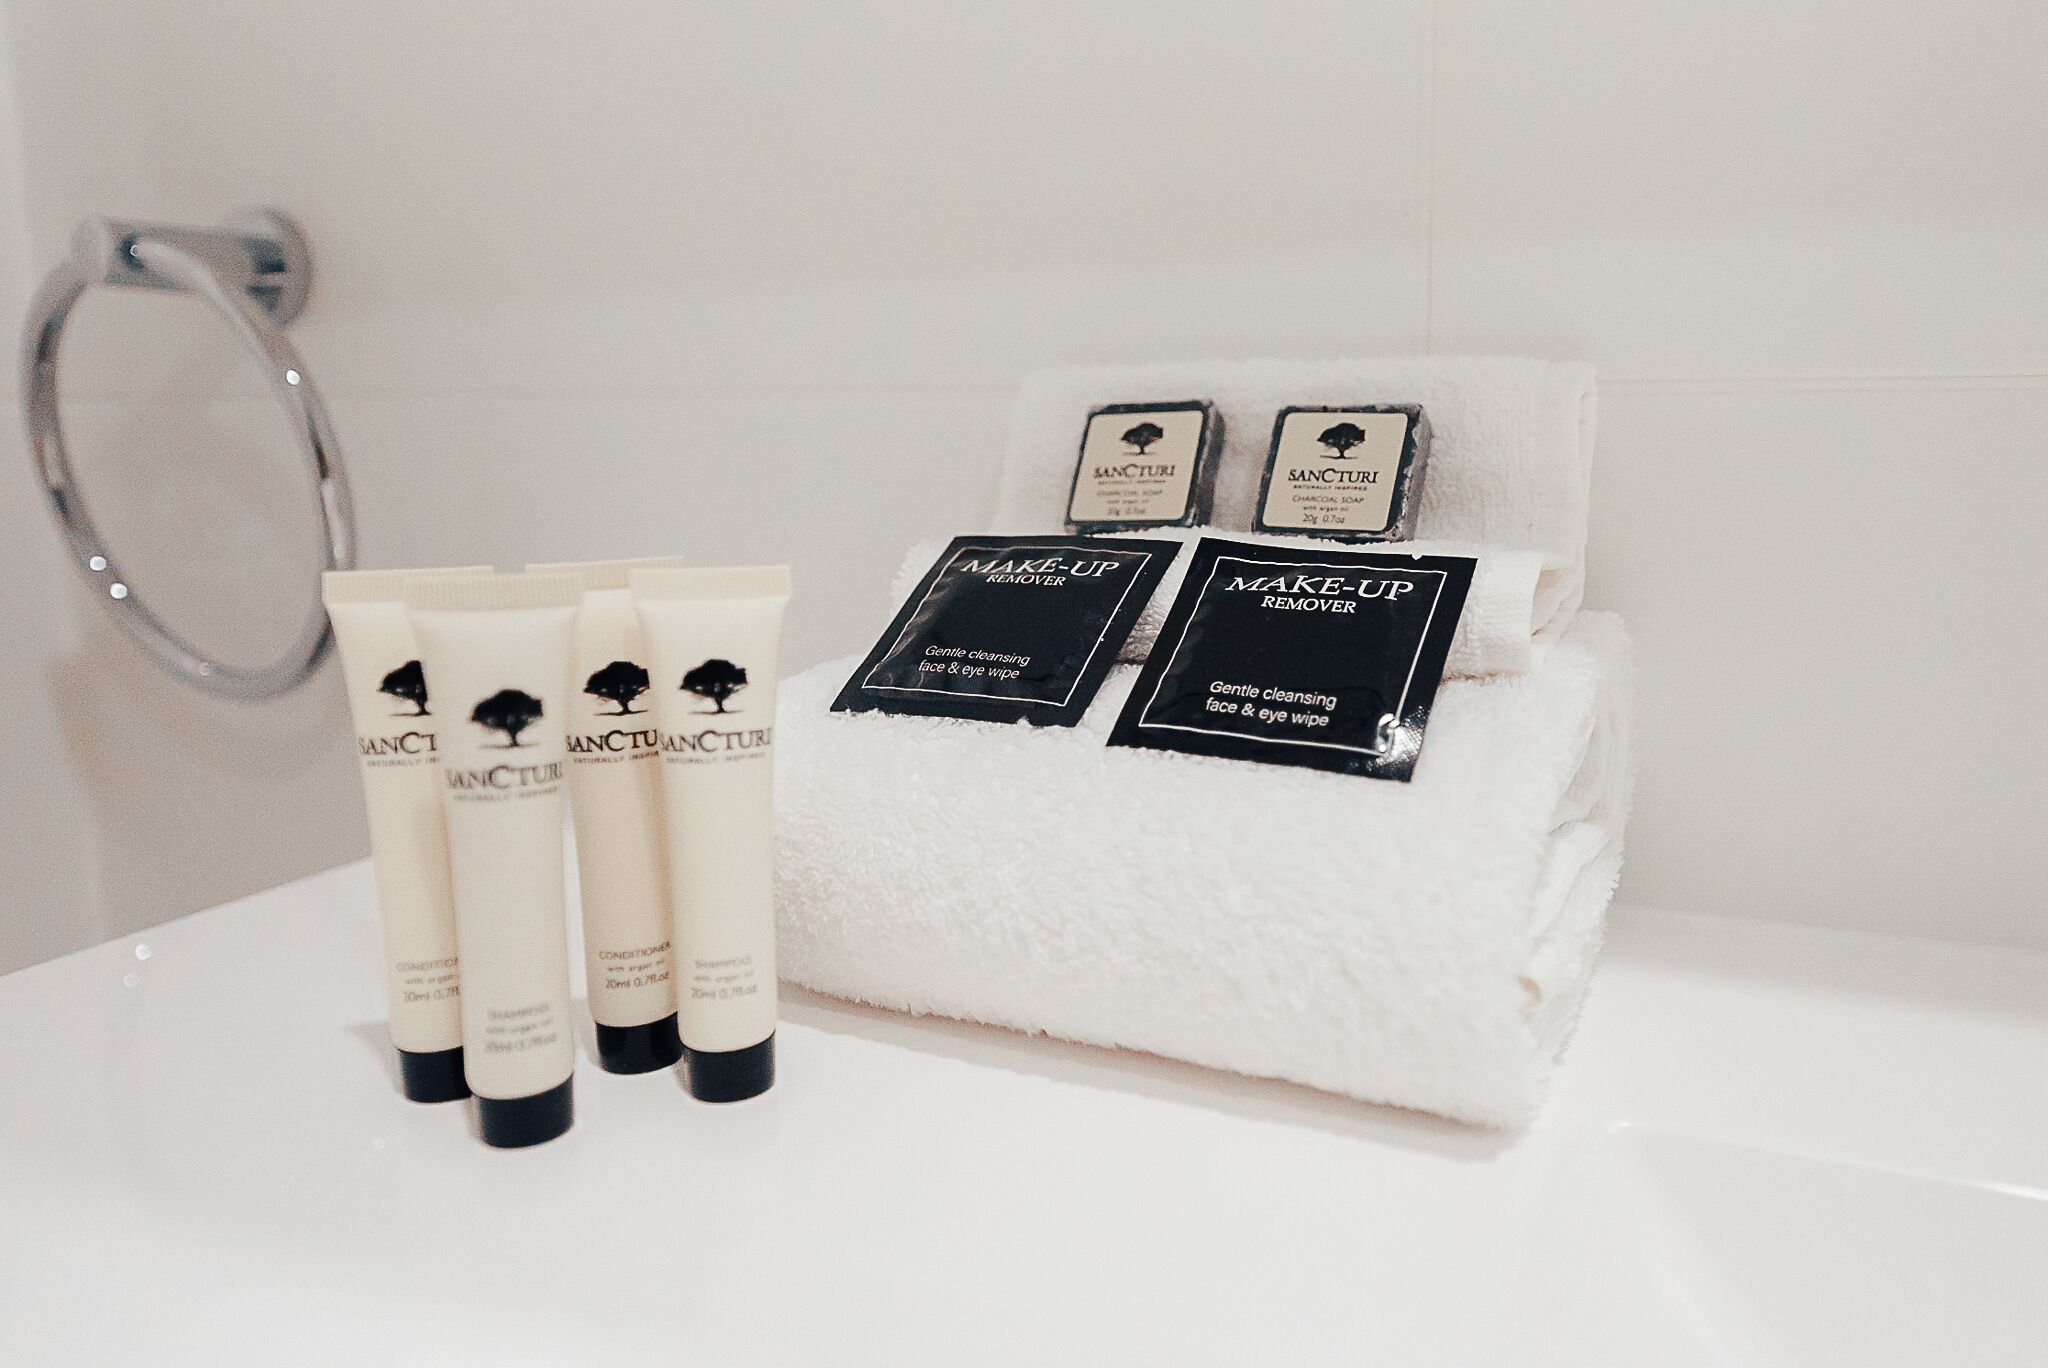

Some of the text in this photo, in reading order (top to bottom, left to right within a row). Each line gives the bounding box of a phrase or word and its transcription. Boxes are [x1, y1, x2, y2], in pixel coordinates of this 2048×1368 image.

[1288, 468, 1380, 483] SANCTURI
[1292, 495, 1365, 504] CHARCOAL SOAP
[1302, 513, 1346, 525] 20g 0.7oz
[961, 557, 1120, 577] MAKE-UP
[985, 573, 1067, 587] REMOVER
[1224, 575, 1415, 601] MAKE-UP
[1260, 595, 1357, 614] REMOVER
[925, 645, 1031, 667] Gentle cleansing
[918, 660, 1020, 681] face & eye wipe
[1209, 681, 1338, 711] Gentle cleansing
[1206, 696, 1330, 728] face & eye wipe
[359, 731, 438, 755] SANCT
[566, 728, 658, 753] SANCTU
[599, 941, 671, 960] CONDITIONER
